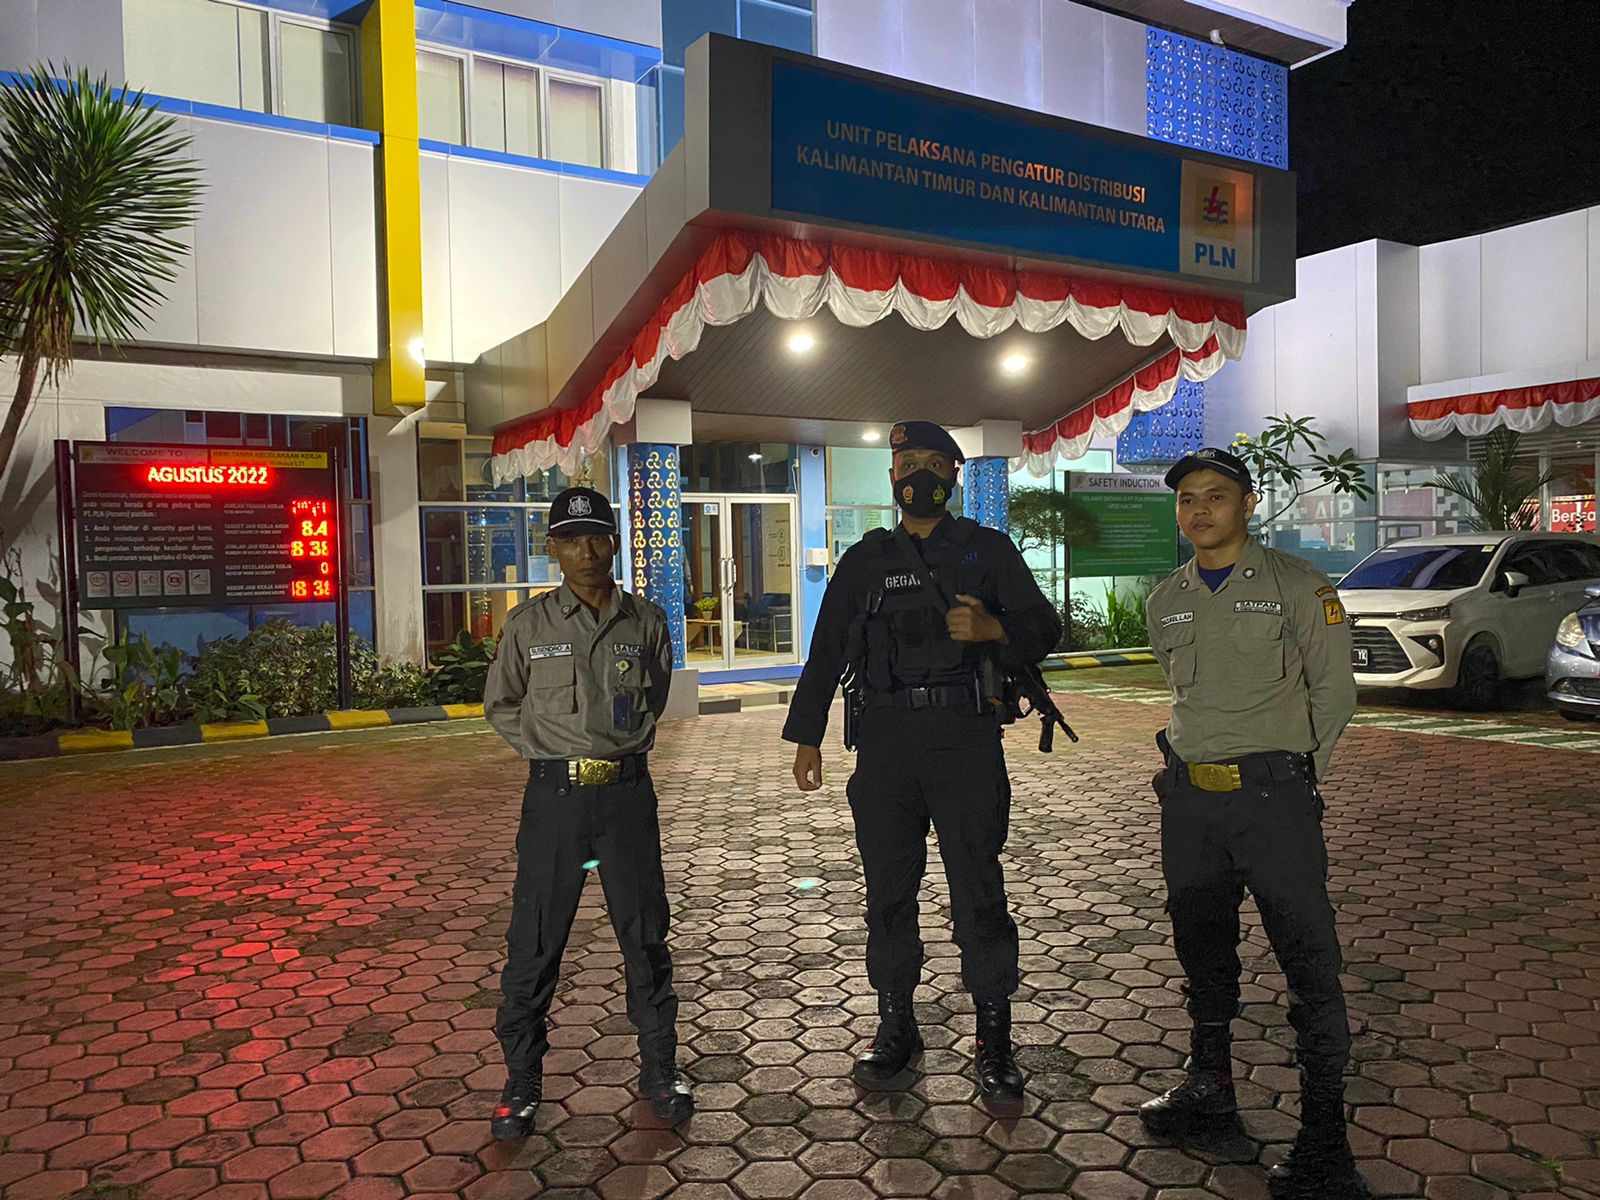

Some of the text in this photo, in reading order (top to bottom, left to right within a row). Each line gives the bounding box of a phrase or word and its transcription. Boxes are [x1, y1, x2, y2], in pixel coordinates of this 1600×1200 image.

[827, 119, 1146, 203] UNIT PELAKSANA PENGATUR DISTRIBUSI
[796, 144, 1166, 233] KALIMANTAN TIMUR DAN KALIMANTAN UTARA
[1195, 242, 1235, 270] PLN
[106, 448, 183, 457] WELCOME TO
[148, 466, 268, 484] AGUSTUS 2022
[1089, 478, 1160, 489] SAFETY INDUCTION
[1239, 601, 1277, 610] SATPAM
